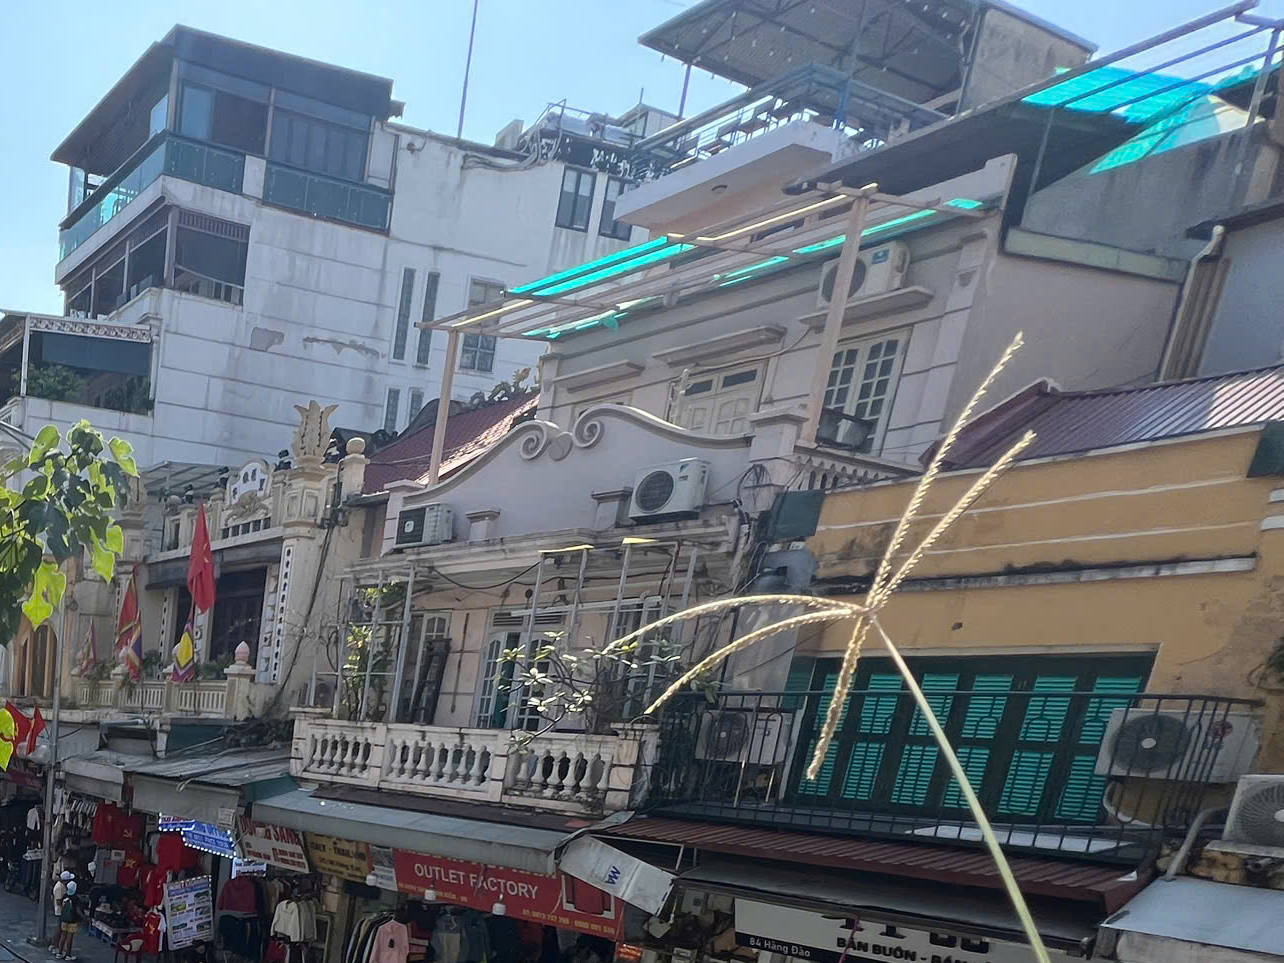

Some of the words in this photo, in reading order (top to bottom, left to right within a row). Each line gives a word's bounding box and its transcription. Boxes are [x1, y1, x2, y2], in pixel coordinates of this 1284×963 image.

[414, 863, 466, 885] OUTLET
[469, 873, 539, 899] FACTORY
[749, 937, 762, 947] 84
[764, 940, 789, 955] Hàng
[791, 945, 811, 957] Đào
[872, 944, 916, 963] BUÔN
